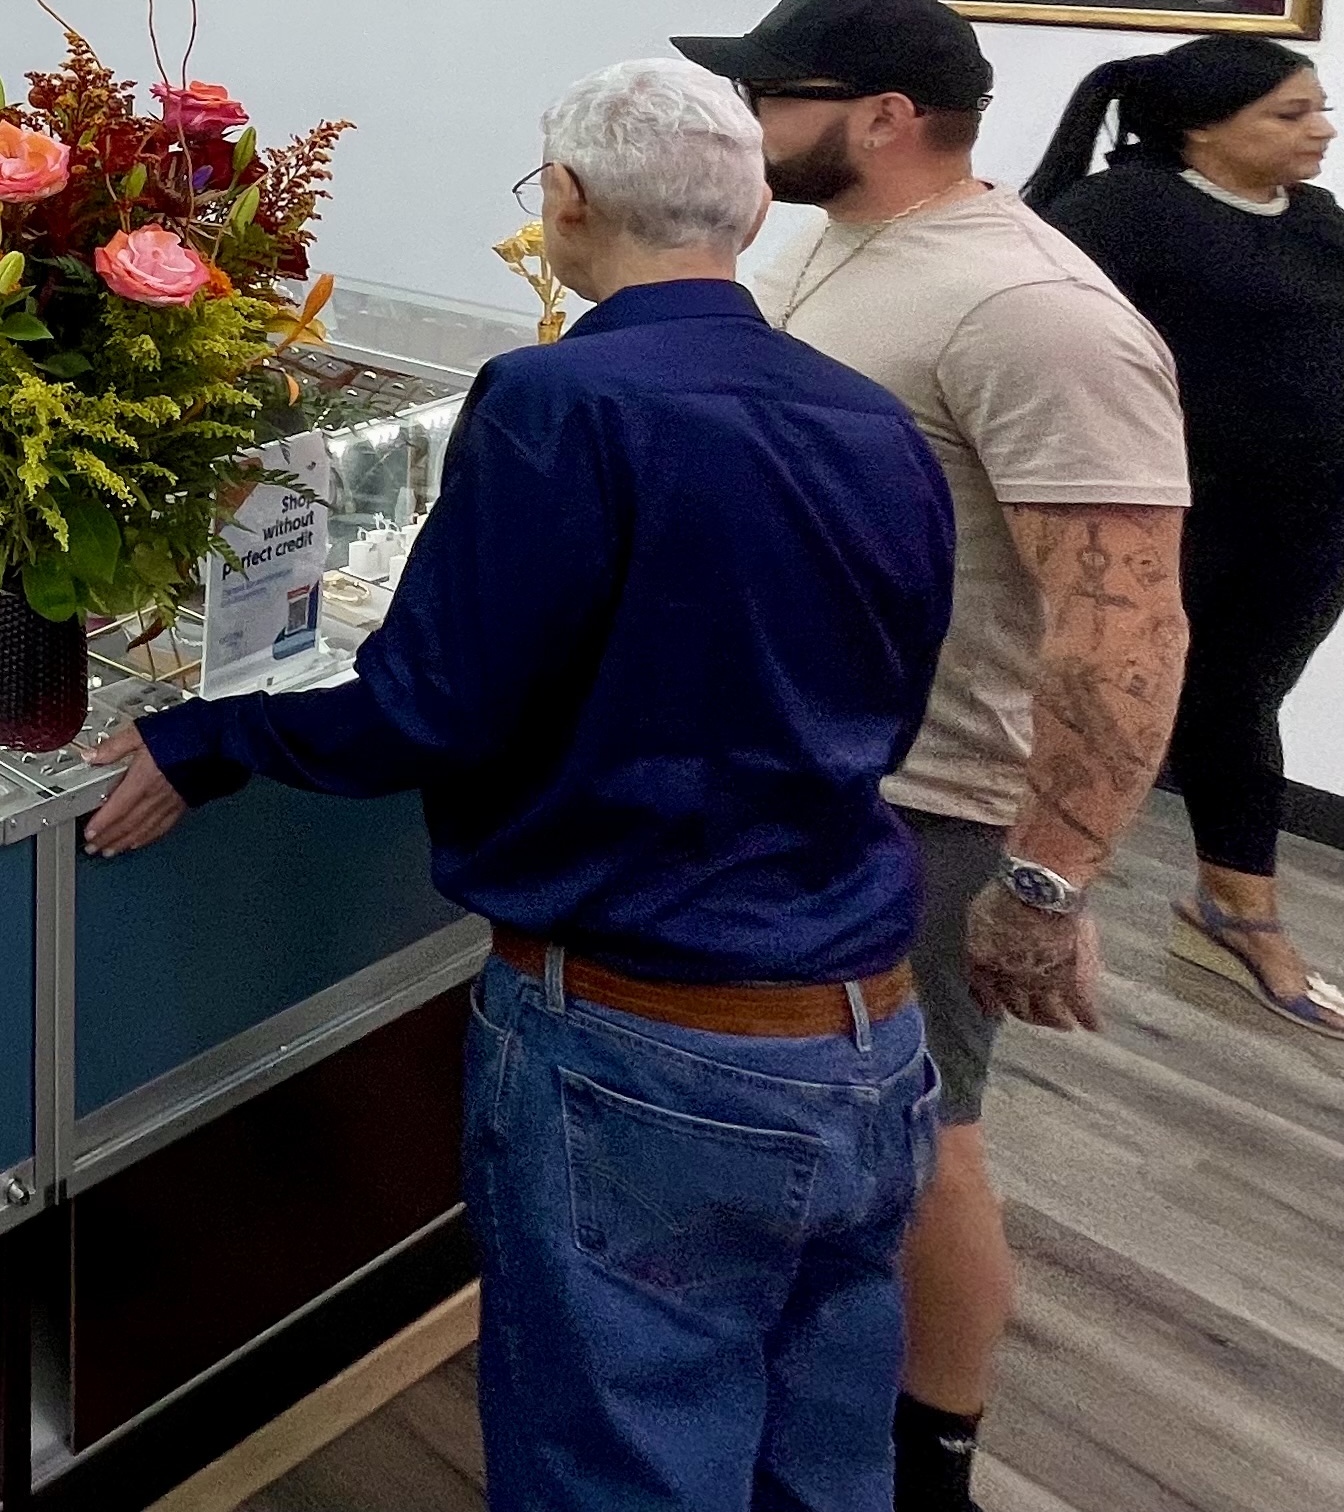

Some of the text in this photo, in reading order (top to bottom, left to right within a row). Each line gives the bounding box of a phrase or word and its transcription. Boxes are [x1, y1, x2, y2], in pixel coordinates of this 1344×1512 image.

[263, 510, 314, 541] without
[222, 531, 314, 581] prfect credit
